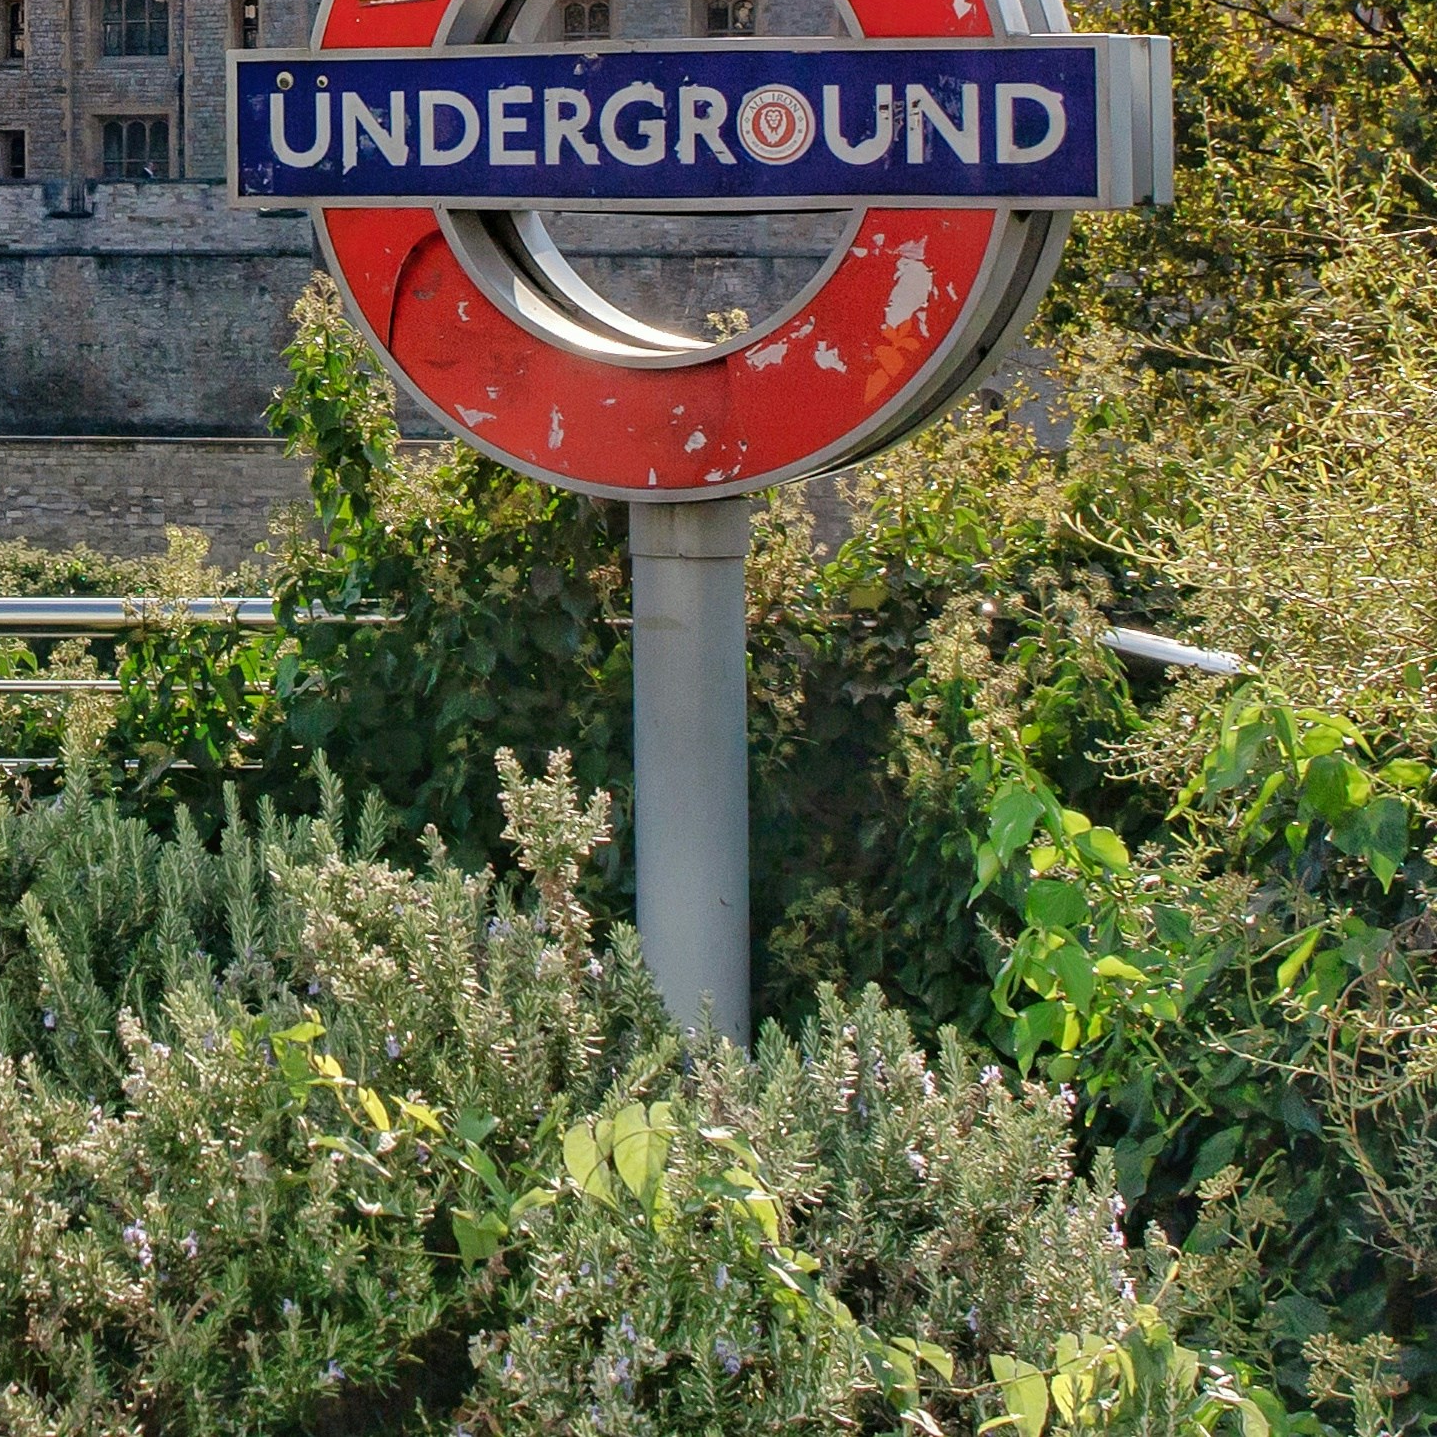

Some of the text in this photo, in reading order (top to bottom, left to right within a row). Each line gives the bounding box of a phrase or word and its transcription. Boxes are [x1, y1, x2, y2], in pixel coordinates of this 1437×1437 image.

[270, 81, 1067, 170] UNDERGROUND
[749, 93, 800, 113] ALL IRON
